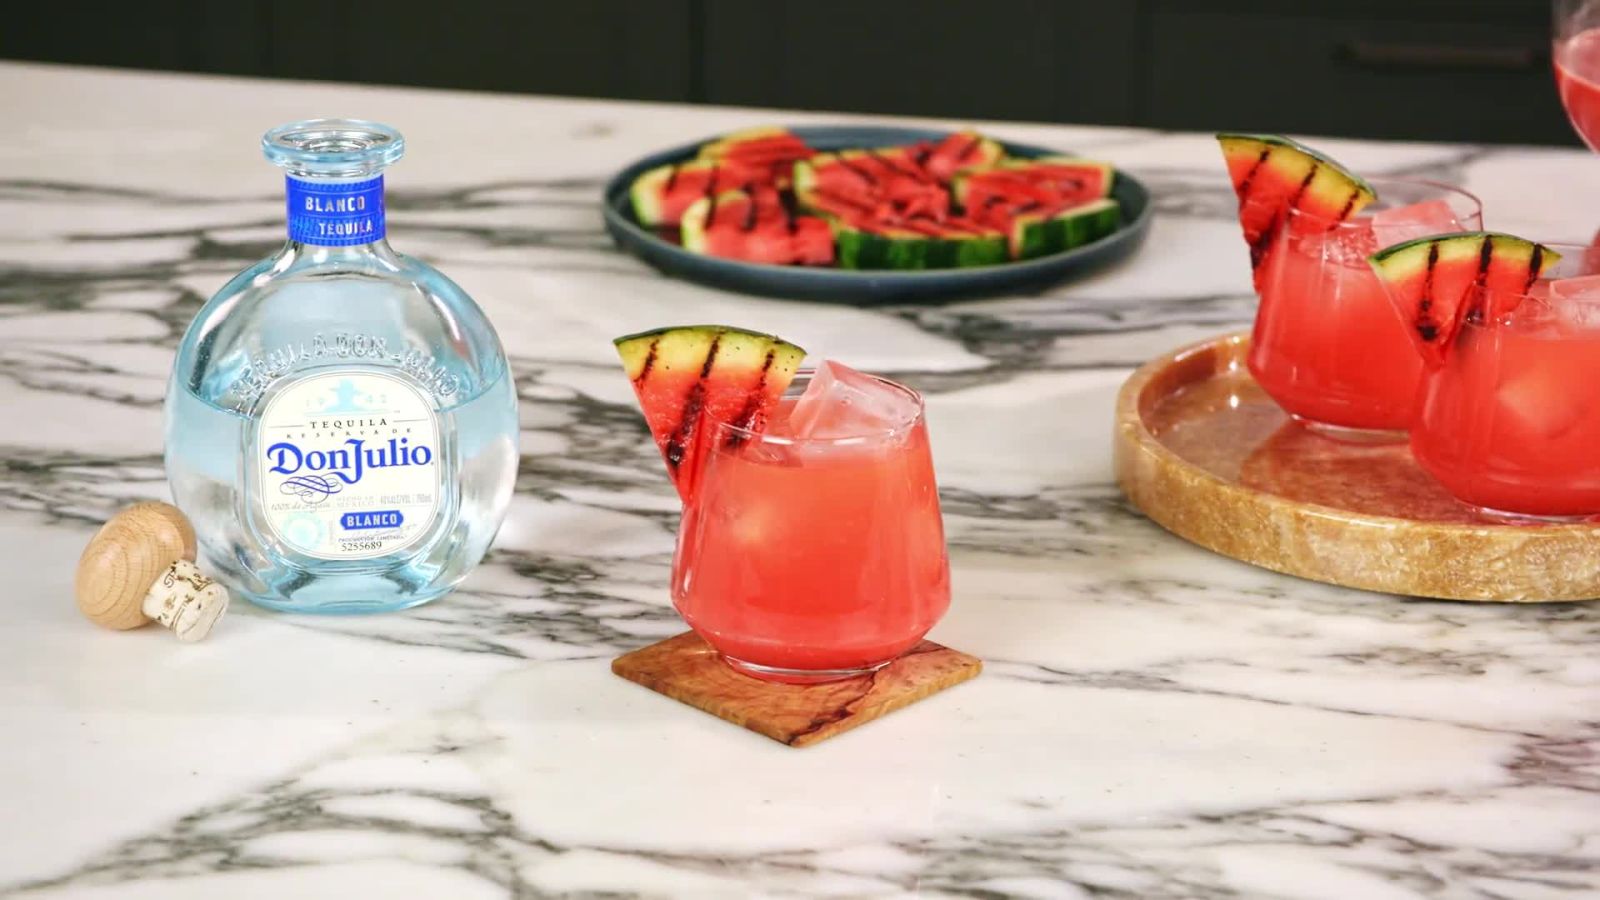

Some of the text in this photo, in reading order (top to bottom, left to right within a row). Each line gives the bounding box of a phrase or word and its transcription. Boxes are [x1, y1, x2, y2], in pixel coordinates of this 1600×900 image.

[305, 196, 365, 212] BLANCO
[319, 219, 373, 235] TEQUILA
[310, 418, 387, 429] TEQUILA
[287, 429, 379, 439] RESERVA
[347, 513, 397, 527] BLANCO
[341, 541, 382, 552] 5255689
